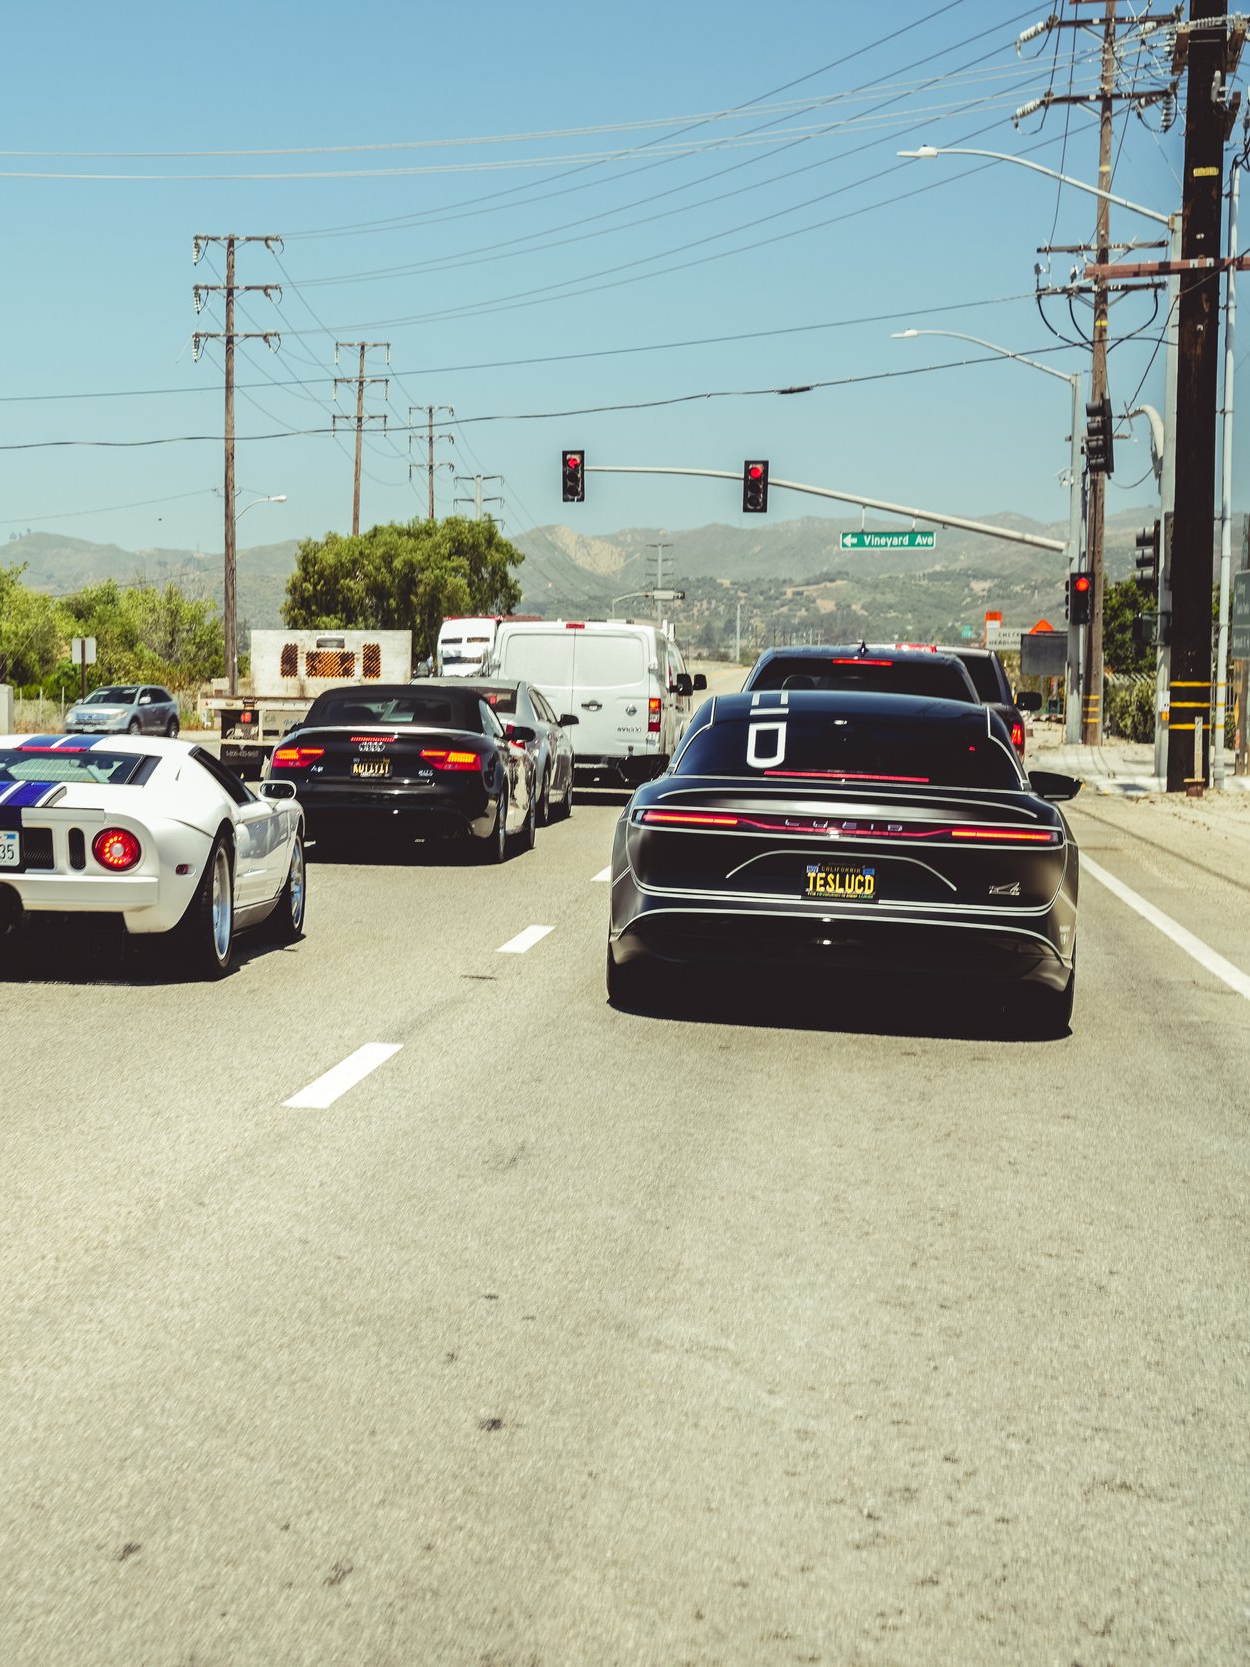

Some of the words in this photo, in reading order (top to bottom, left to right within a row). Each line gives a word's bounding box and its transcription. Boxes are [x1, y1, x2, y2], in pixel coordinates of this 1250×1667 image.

[864, 534, 909, 547] Vineyard
[915, 535, 933, 546] Ave
[807, 872, 875, 895] TESLUCD
